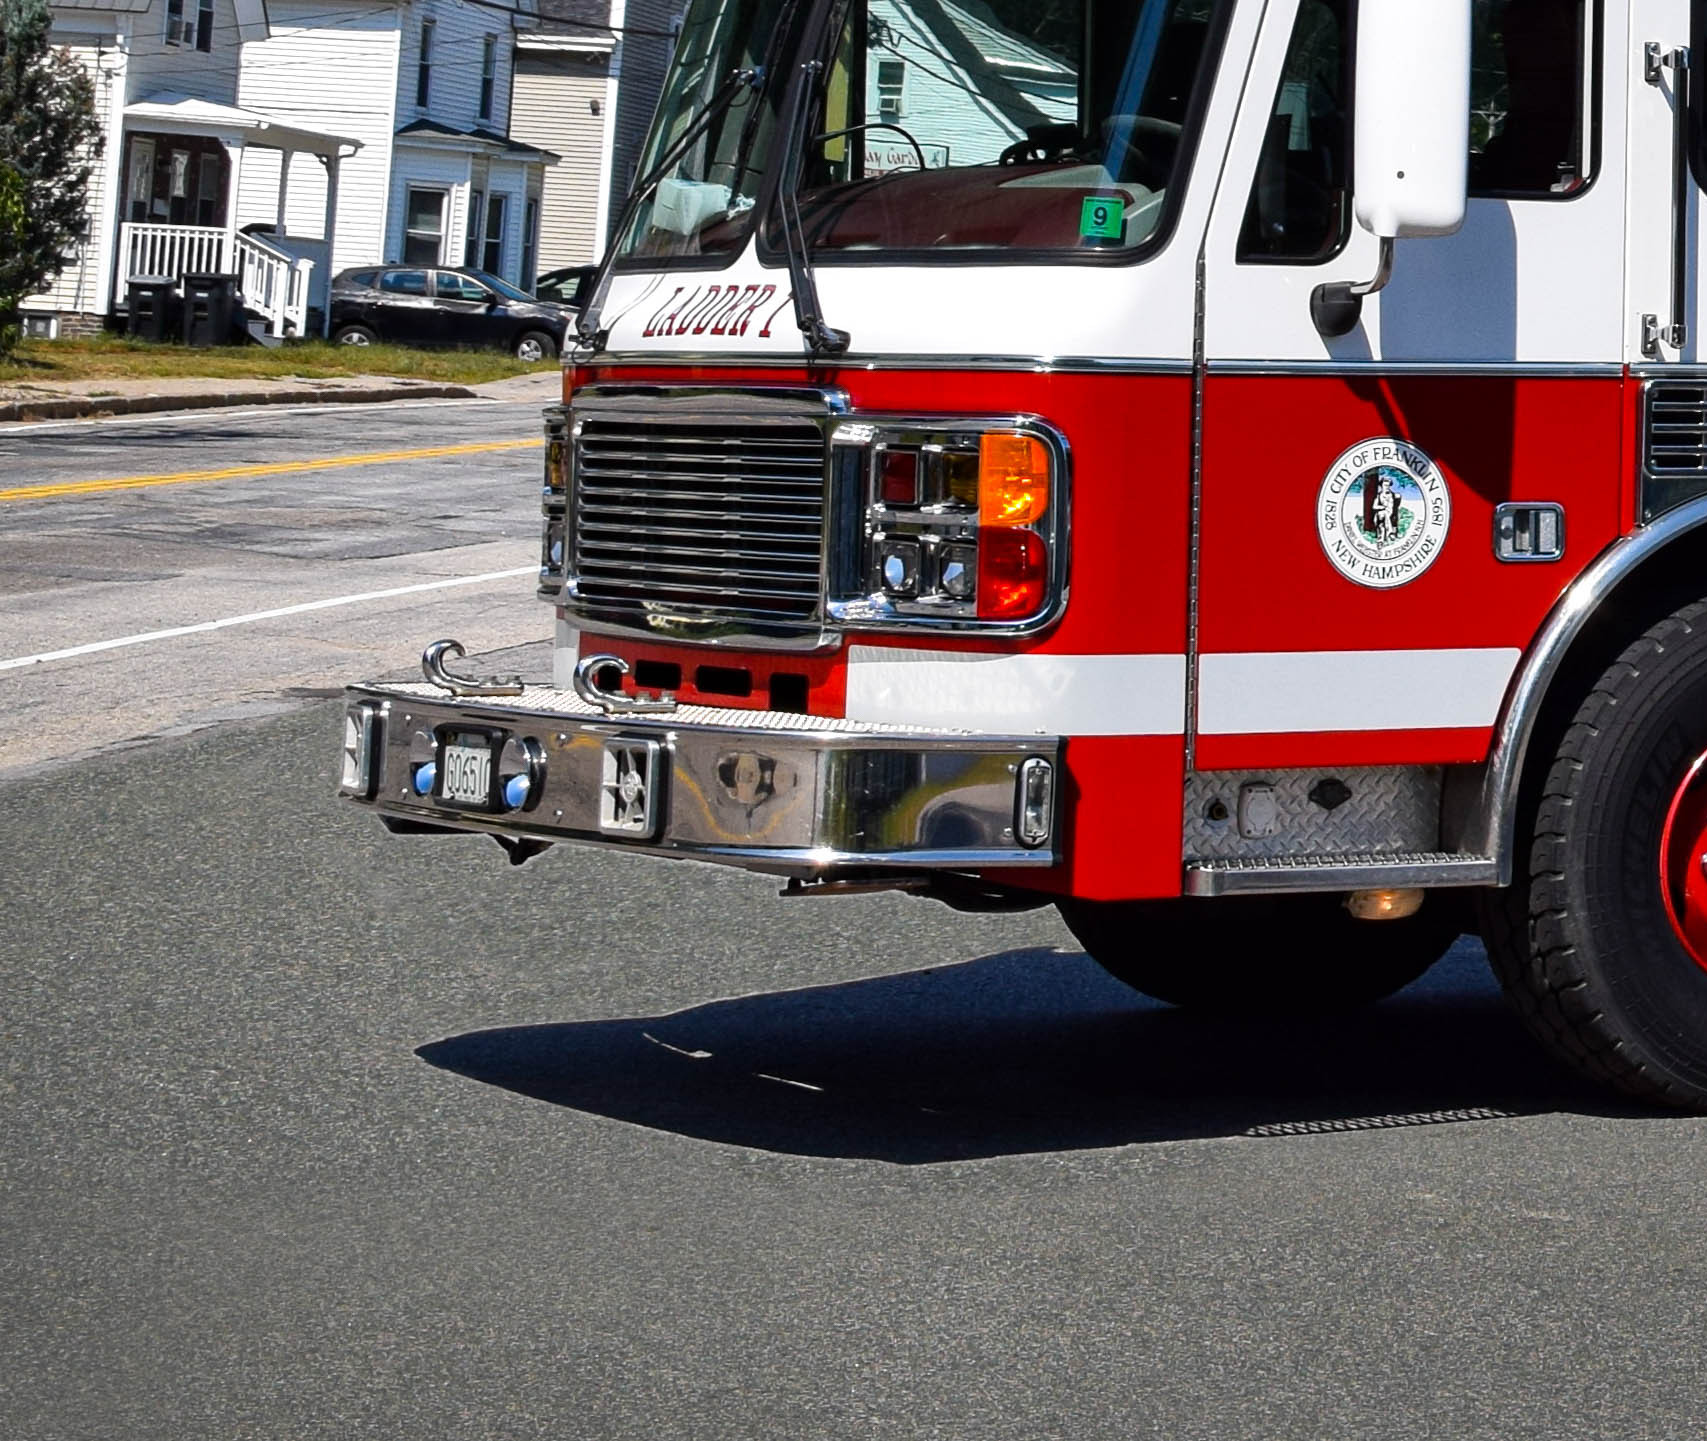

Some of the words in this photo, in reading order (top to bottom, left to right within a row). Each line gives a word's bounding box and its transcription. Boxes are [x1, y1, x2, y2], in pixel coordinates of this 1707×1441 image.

[1093, 206, 1108, 226] 9
[642, 284, 776, 338] LADDER
[758, 290, 793, 338] 1
[1352, 450, 1369, 468] OF
[1373, 446, 1439, 493] FRANKLIN
[1330, 464, 1352, 494] CITY
[1325, 499, 1338, 531] 1828
[1431, 497, 1444, 527] 1895
[1332, 539, 1361, 569] NEW
[1361, 535, 1438, 580] HAMPSHIRE
